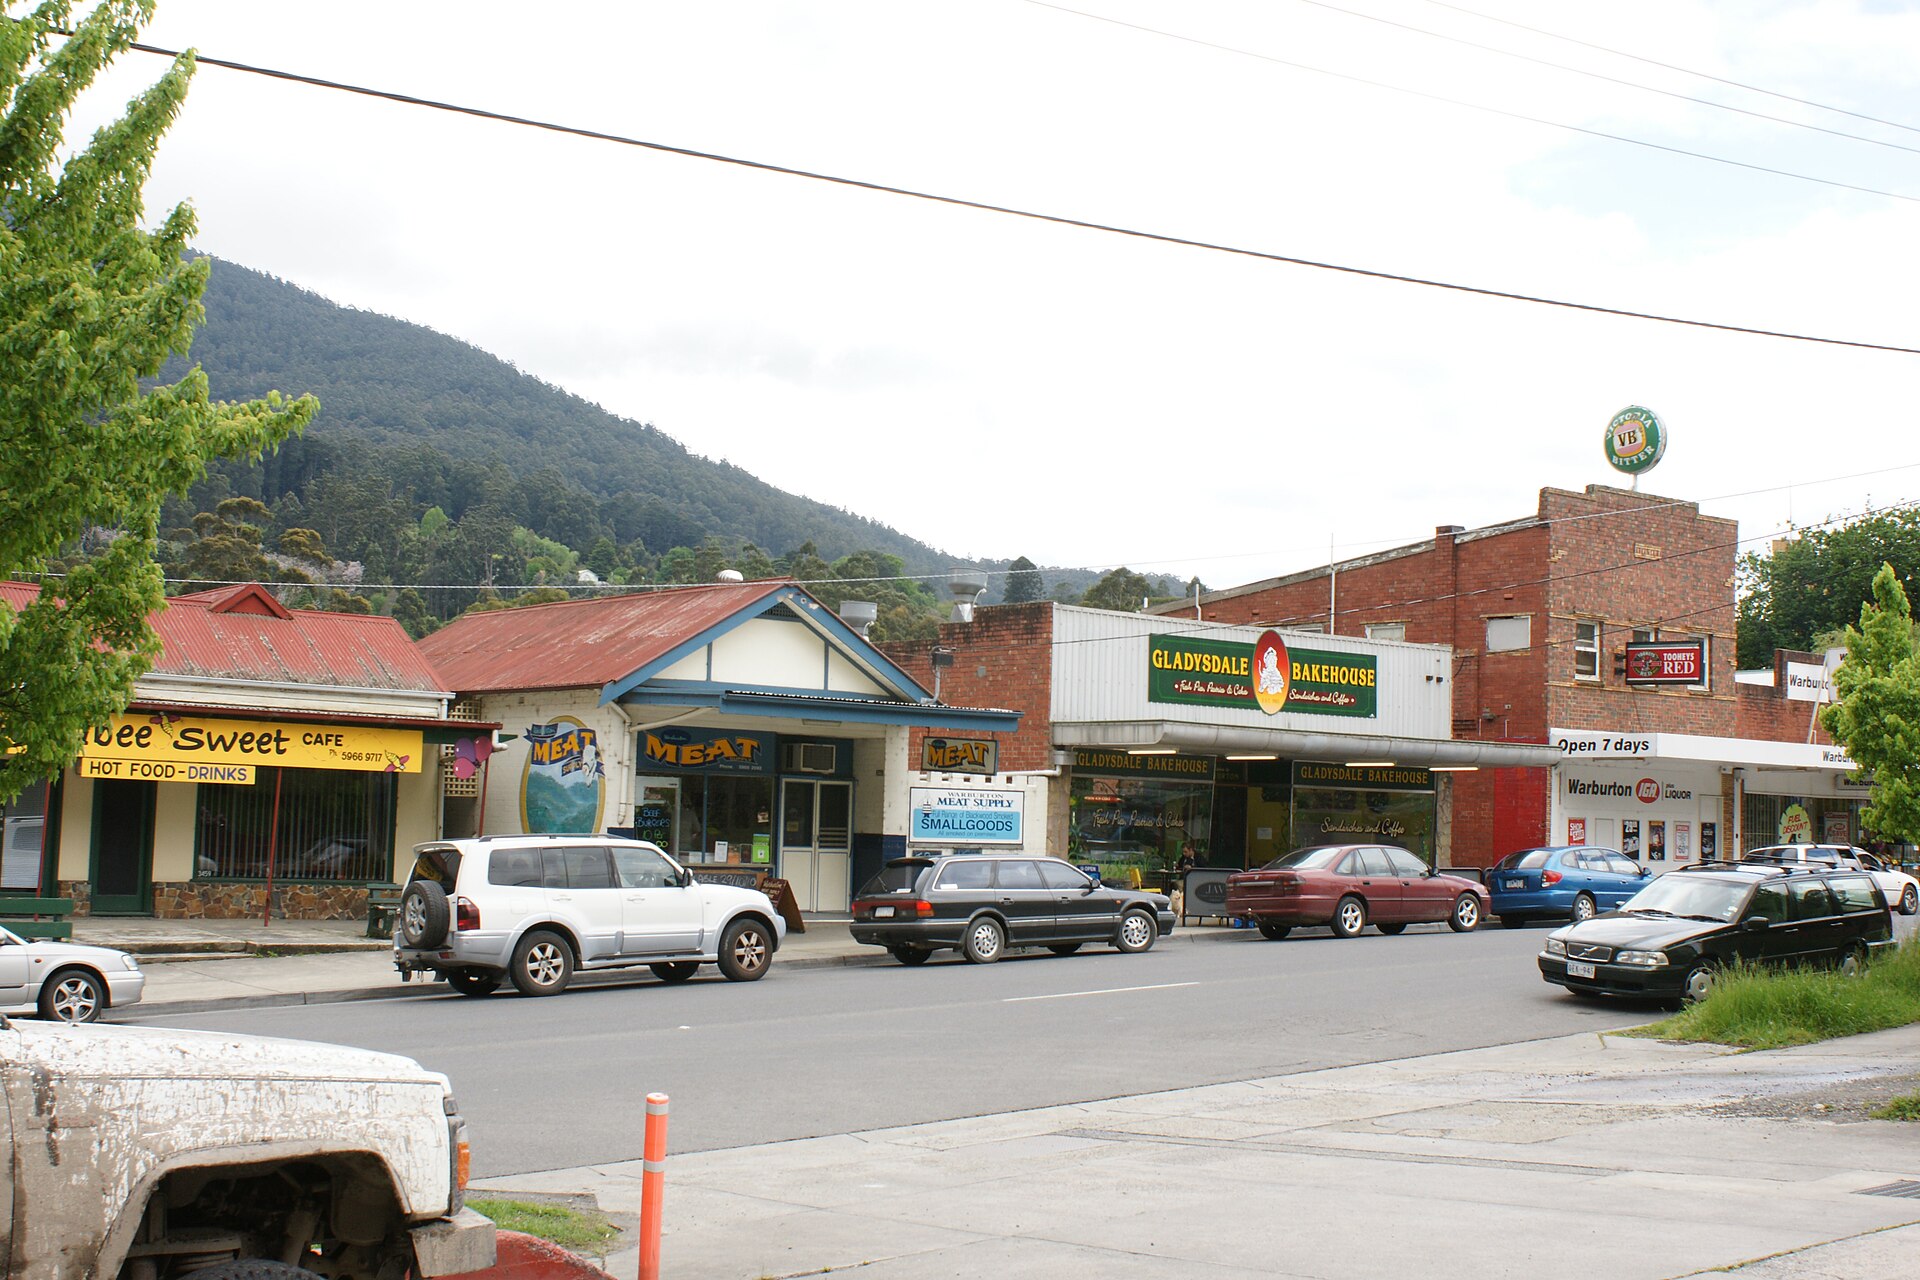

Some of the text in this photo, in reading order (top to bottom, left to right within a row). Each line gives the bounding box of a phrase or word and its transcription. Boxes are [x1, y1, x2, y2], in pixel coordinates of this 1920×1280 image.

[1606, 411, 1653, 440] VICTORIA
[1618, 430, 1638, 447] VB
[1612, 445, 1656, 466] BITTER
[1663, 652, 1695, 661] TOOHEYS
[1152, 649, 1376, 687] GLADYSDALE BAKEHOUSE
[1663, 661, 1695, 675] RED
[1320, 692, 1332, 702] and
[1332, 691, 1350, 706] Coffee
[172, 727, 291, 755] Sweet
[302, 732, 344, 747] CAFE
[533, 731, 593, 762] MEAT
[1558, 738, 1649, 754] Open 7 days
[341, 751, 363, 761] 5966
[365, 752, 382, 762] 9717
[645, 734, 761, 767] MEAT
[928, 742, 989, 768] MEAT
[90, 761, 122, 775] HOT
[1078, 752, 1208, 774] GLADYSDALE BAKEHOUSE
[1301, 766, 1428, 784] GLADYSDALE BAKEHOUSE
[948, 791, 1004, 799] WARBURTON
[1568, 778, 1658, 798] Warburton IGA
[1665, 790, 1692, 800] LIQUOR
[937, 797, 1013, 808] MEAT SUPPLY
[941, 811, 958, 820] Range
[994, 812, 1013, 820] Smoked
[1787, 814, 1801, 824] FUEL
[921, 818, 1013, 832] SMALLGOODS
[1320, 816, 1405, 838] Sandwiches and Coffee
[1570, 822, 1583, 830] SHOP
[1783, 822, 1808, 835] DISCOUNT
[1573, 831, 1584, 840] SAVE
